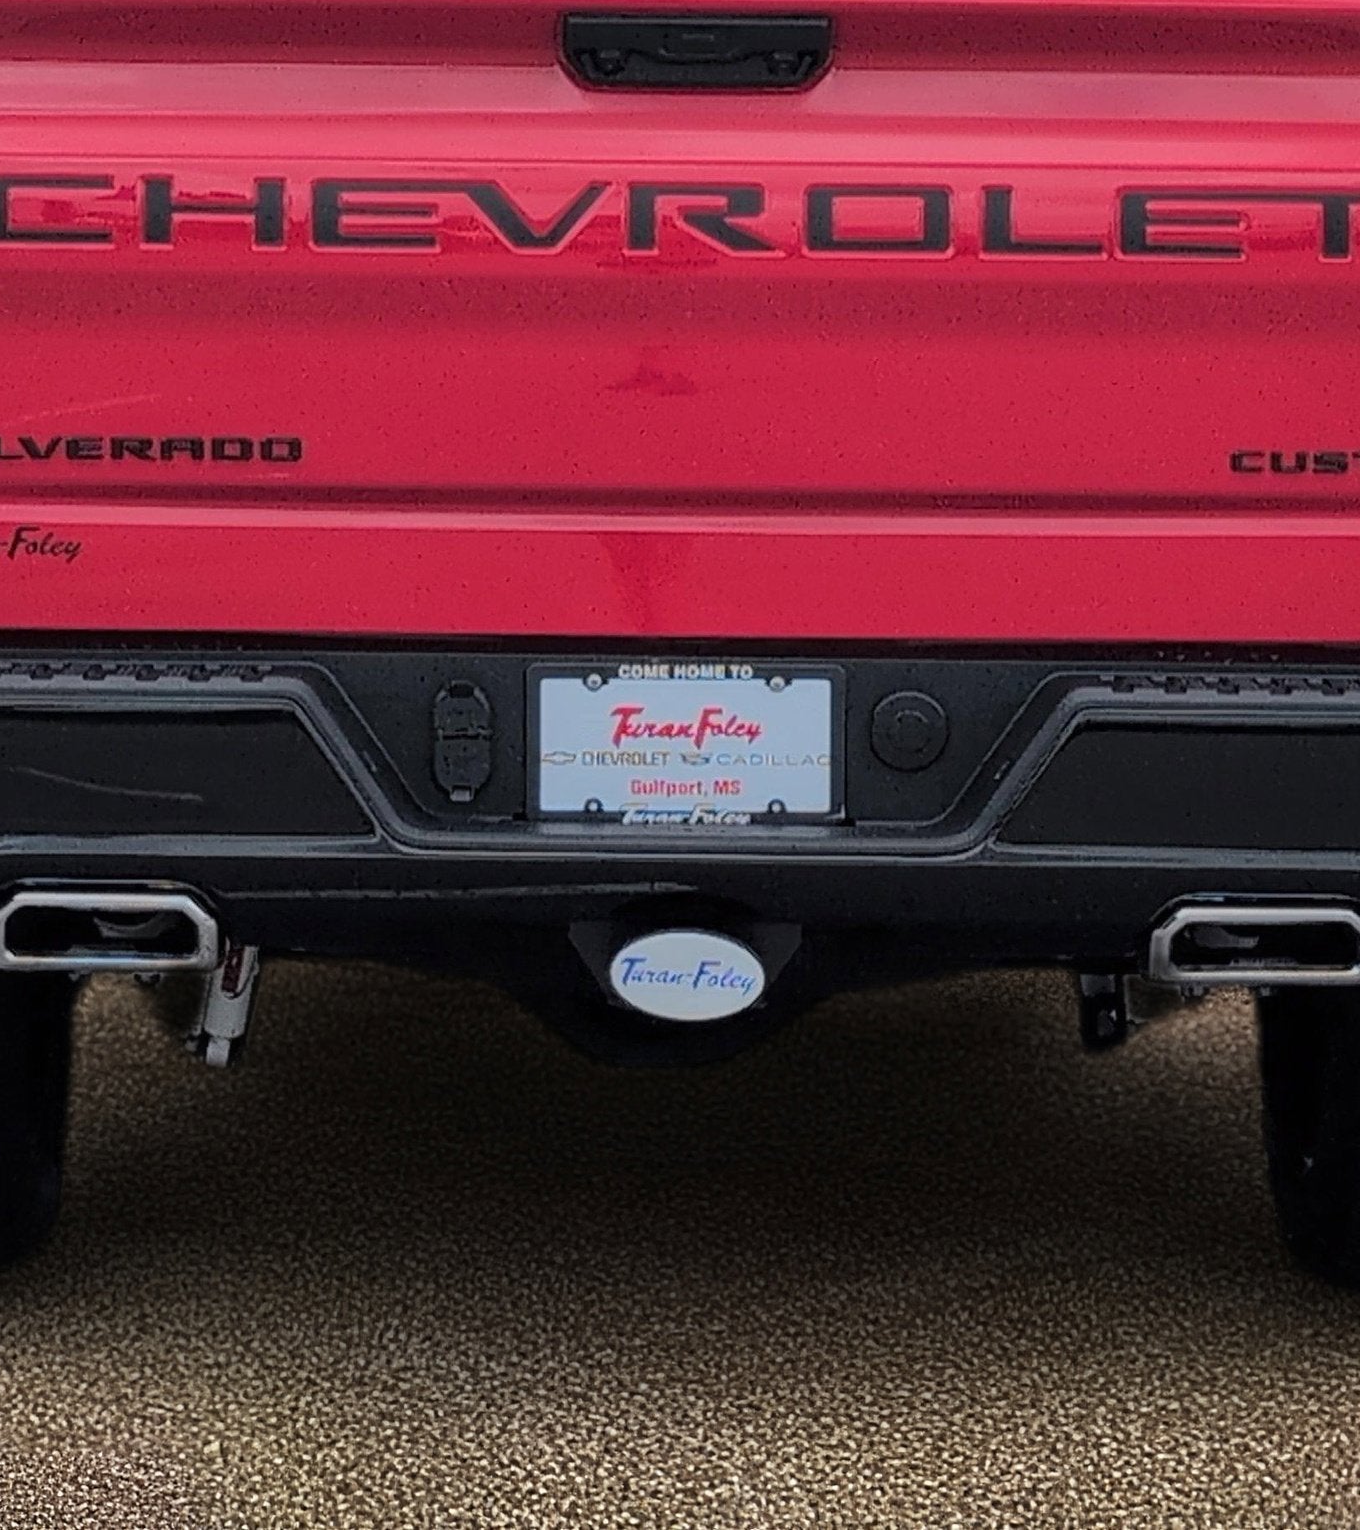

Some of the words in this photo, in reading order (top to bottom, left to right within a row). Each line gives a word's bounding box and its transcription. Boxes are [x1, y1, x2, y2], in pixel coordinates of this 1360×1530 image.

[618, 664, 669, 679] COME
[673, 664, 725, 679] HOME
[729, 664, 753, 679] TO
[581, 751, 670, 766] CHEVROLET
[716, 753, 830, 766] CADILLAC
[630, 779, 708, 798] Gulfport,
[713, 780, 741, 795] MS
